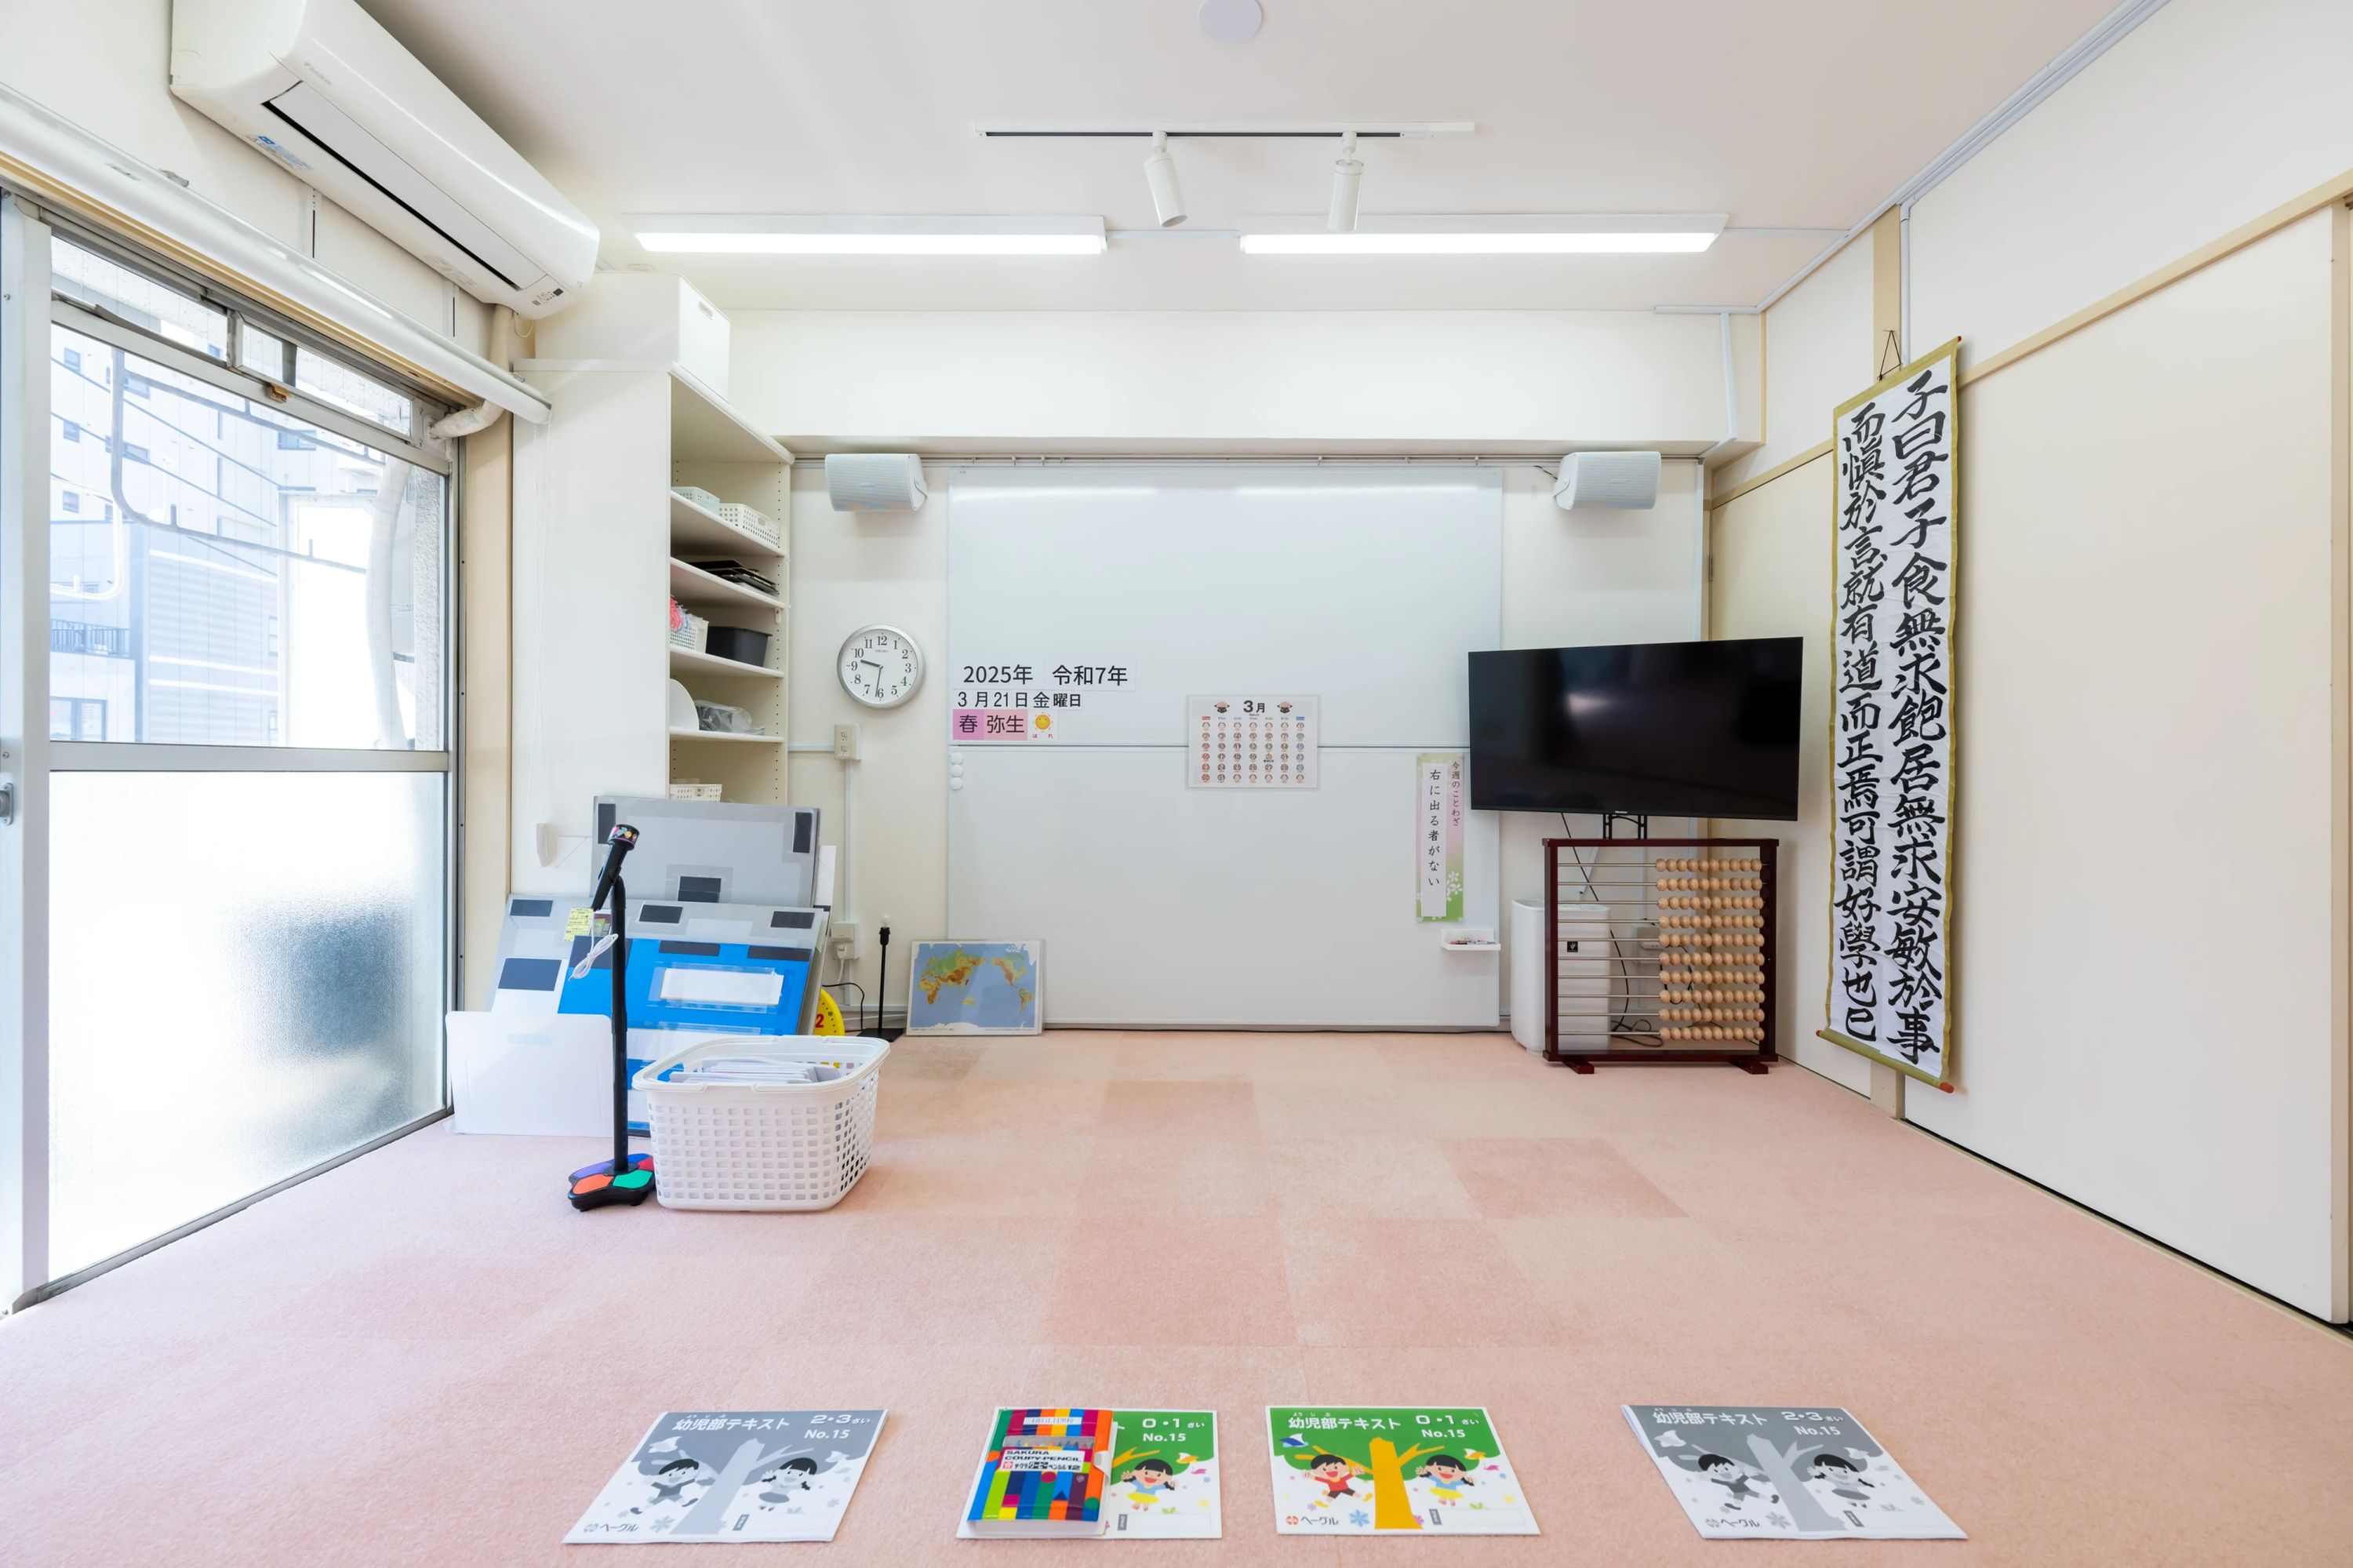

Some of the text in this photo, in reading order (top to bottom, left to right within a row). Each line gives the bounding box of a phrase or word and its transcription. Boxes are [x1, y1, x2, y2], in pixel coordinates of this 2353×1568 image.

[865, 639, 872, 648] 11
[878, 636, 887, 645] 12
[894, 640, 897, 649] 1
[855, 649, 864, 657] 10
[902, 649, 908, 659] 2
[852, 661, 857, 671] 9
[905, 663, 911, 672] 3
[854, 675, 860, 684] 8
[963, 664, 1128, 686] 2025年 令和7年
[900, 676, 907, 686] 4
[864, 685, 870, 694] 7
[878, 689, 883, 698] 6
[891, 686, 897, 695] 5
[1243, 700, 1265, 713] 3月
[959, 715, 1024, 733] 春 弥生
[1451, 762, 1460, 827] 今週のことわざ
[1427, 769, 1442, 886] 右に出る者がない
[816, 1013, 824, 1028] 2
[1288, 1417, 1401, 1429] 幼児部テキスト
[1653, 1411, 1768, 1425] 幼児部テキスト
[672, 1417, 789, 1431] 幼児部テキスト
[804, 1428, 851, 1439] No.15
[1421, 1429, 1466, 1438] No.15
[1793, 1425, 1841, 1435] No.15
[1143, 1433, 1186, 1442] No.15
[1300, 1516, 1339, 1526] ヘーグル
